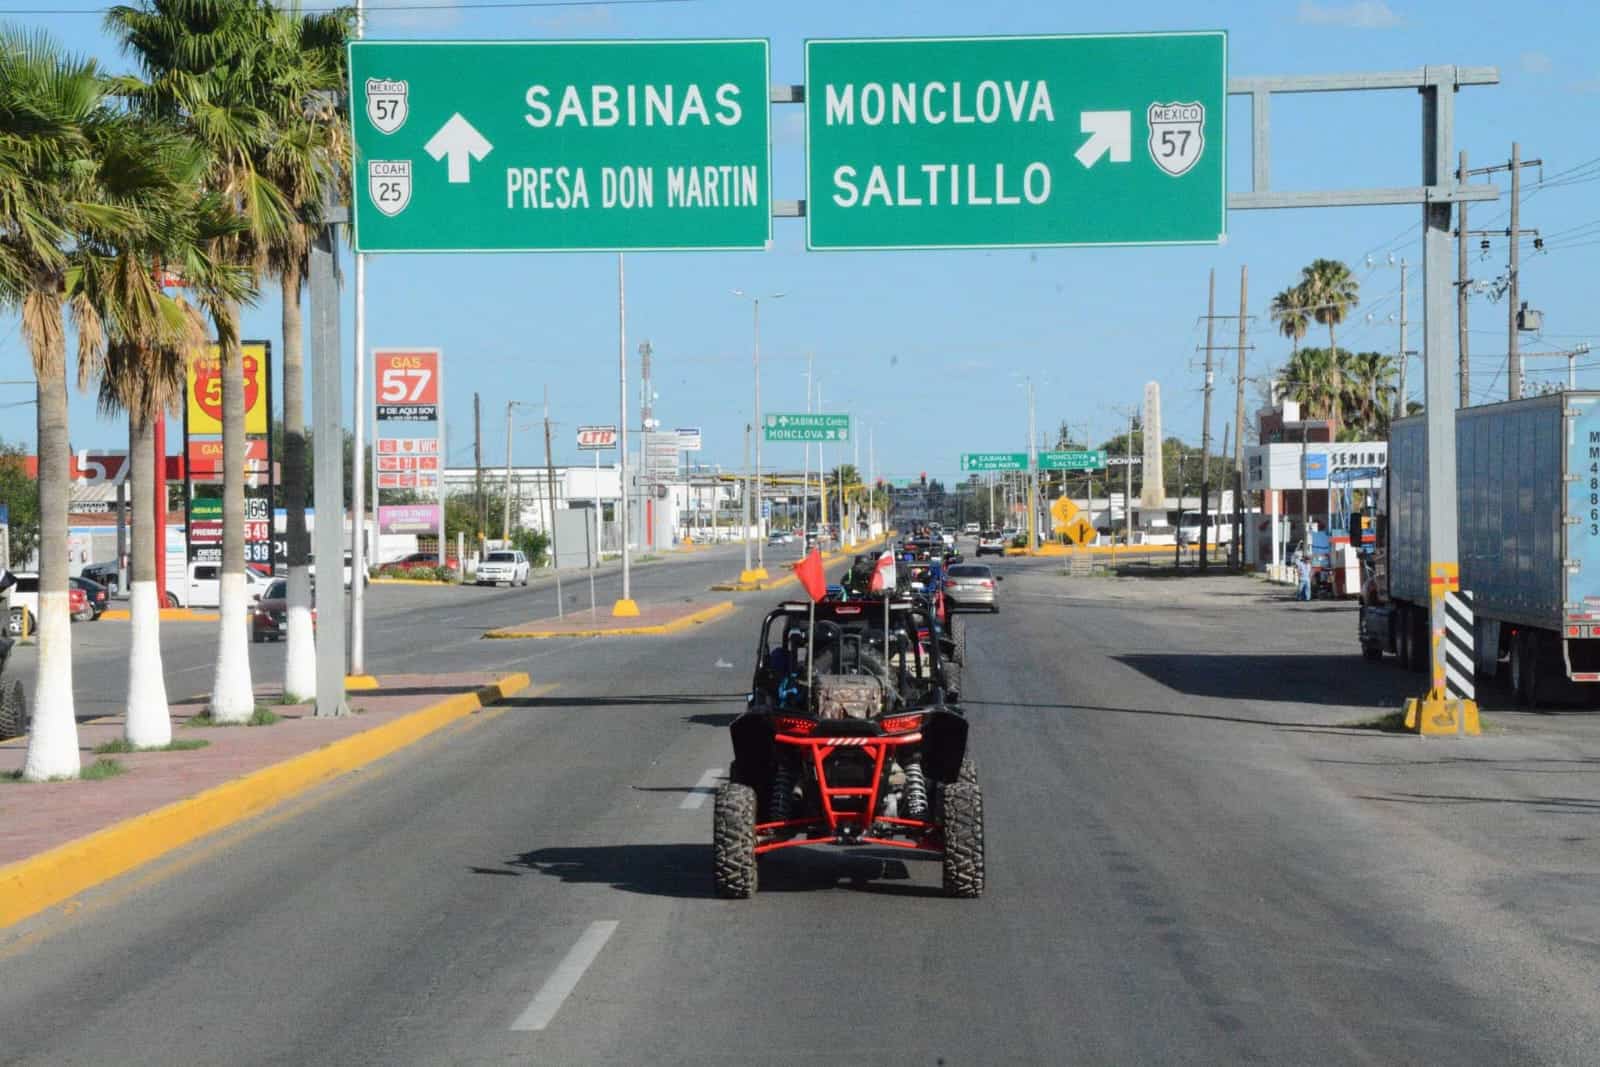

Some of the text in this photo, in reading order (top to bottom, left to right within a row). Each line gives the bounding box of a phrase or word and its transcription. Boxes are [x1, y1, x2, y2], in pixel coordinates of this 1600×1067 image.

[370, 84, 403, 92] MEXICO
[376, 100, 399, 120] 57
[525, 83, 742, 129] SABINAS
[825, 80, 1055, 126] MONCLOVA
[1154, 107, 1199, 120] MEXICO
[1161, 131, 1191, 157] 57
[374, 164, 405, 175] COAH
[379, 182, 402, 202] 25
[507, 165, 758, 209] PRESA DON MARTIN
[832, 162, 1052, 207] SALTILLO
[392, 356, 422, 368] GAS
[382, 369, 432, 402] 57
[582, 431, 612, 444] LTH
[769, 429, 824, 439] MONCLOVA
